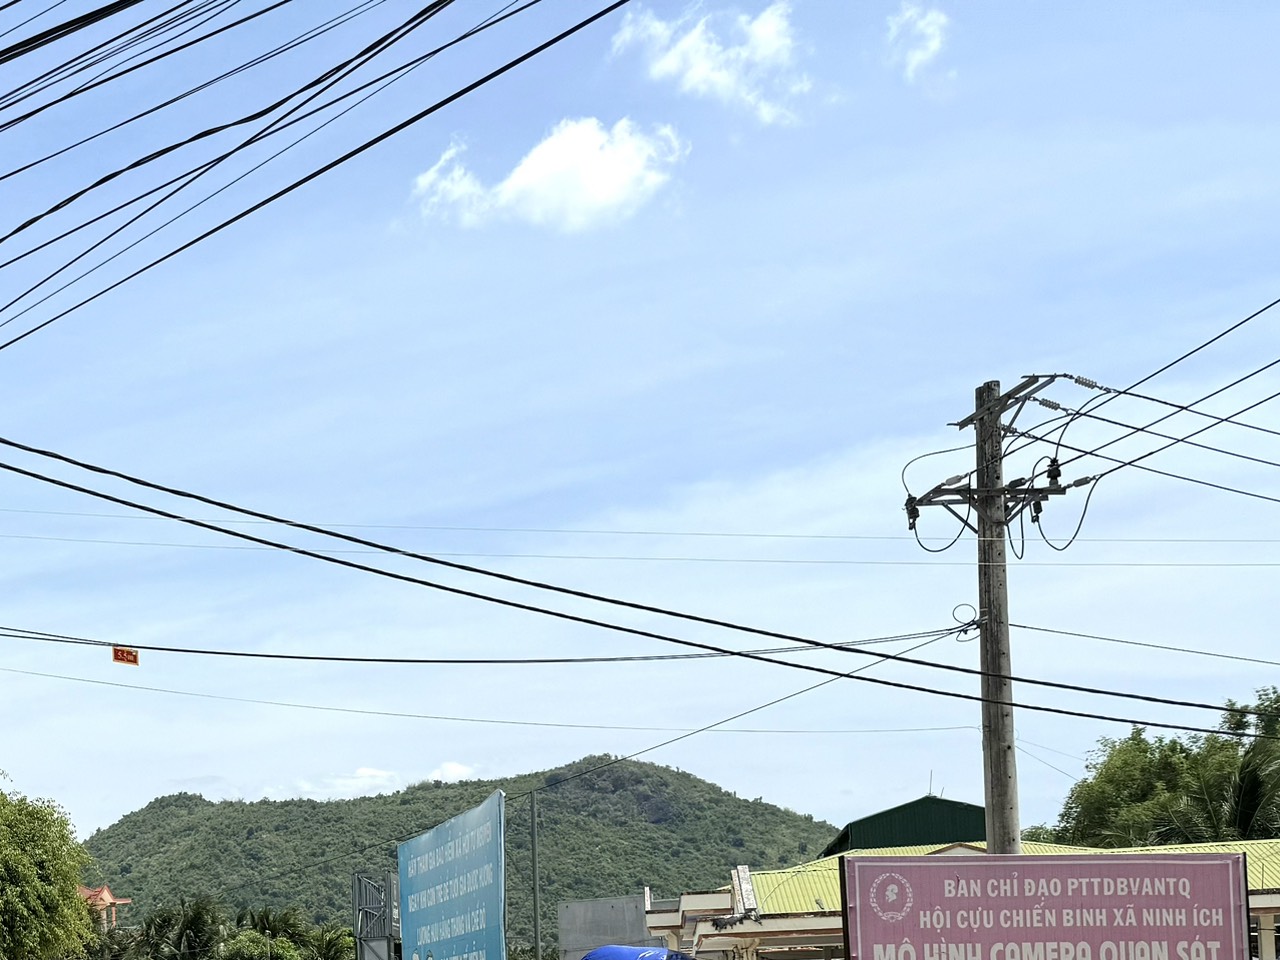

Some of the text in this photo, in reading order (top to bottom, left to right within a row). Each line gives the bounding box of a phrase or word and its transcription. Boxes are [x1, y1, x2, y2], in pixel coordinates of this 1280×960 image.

[944, 871, 1191, 900] BAN CHỈ ĐẠO PTTDBVANTQ
[920, 902, 1223, 932] HỘI CỰU CHIẾN BINH XÃ NINH ÍCH
